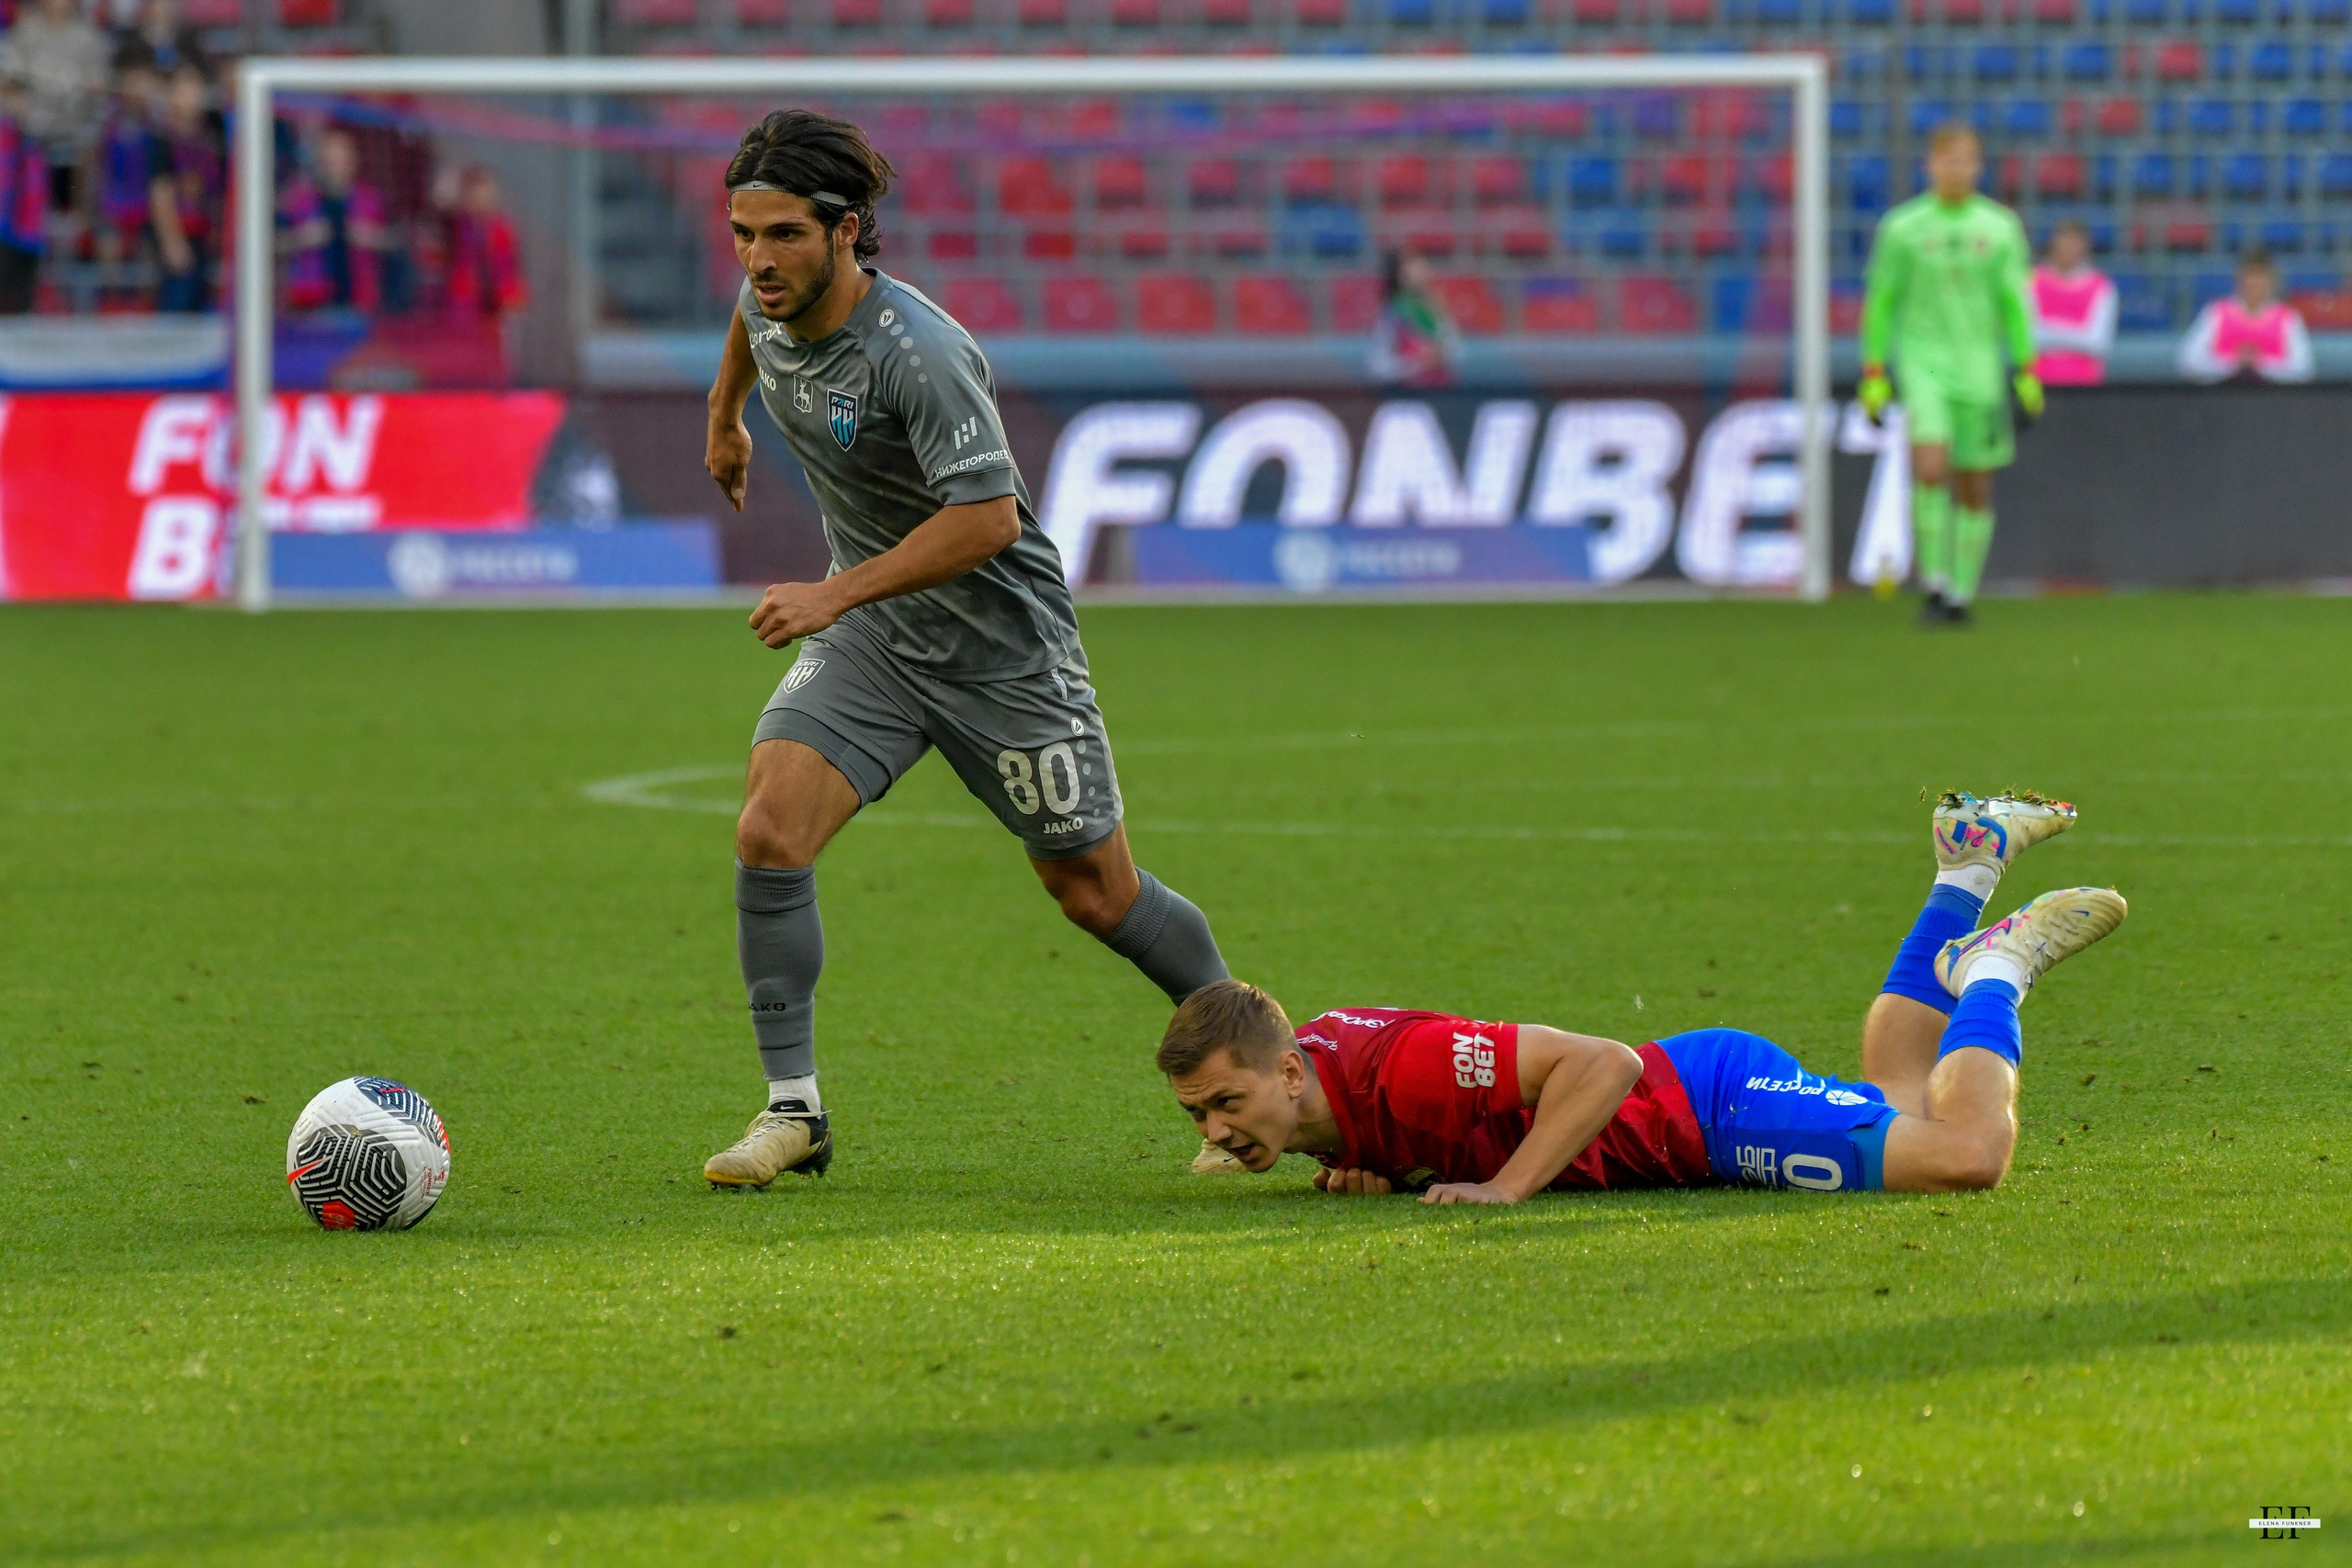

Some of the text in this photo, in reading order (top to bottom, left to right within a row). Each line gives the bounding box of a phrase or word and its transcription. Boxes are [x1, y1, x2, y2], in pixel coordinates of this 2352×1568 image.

[1038, 400, 1914, 586] FONBET
[997, 741, 1080, 816] 80
[1043, 817, 1084, 834] JAKO
[1453, 1032, 1478, 1089] FON
[1474, 1032, 1496, 1088] BET
